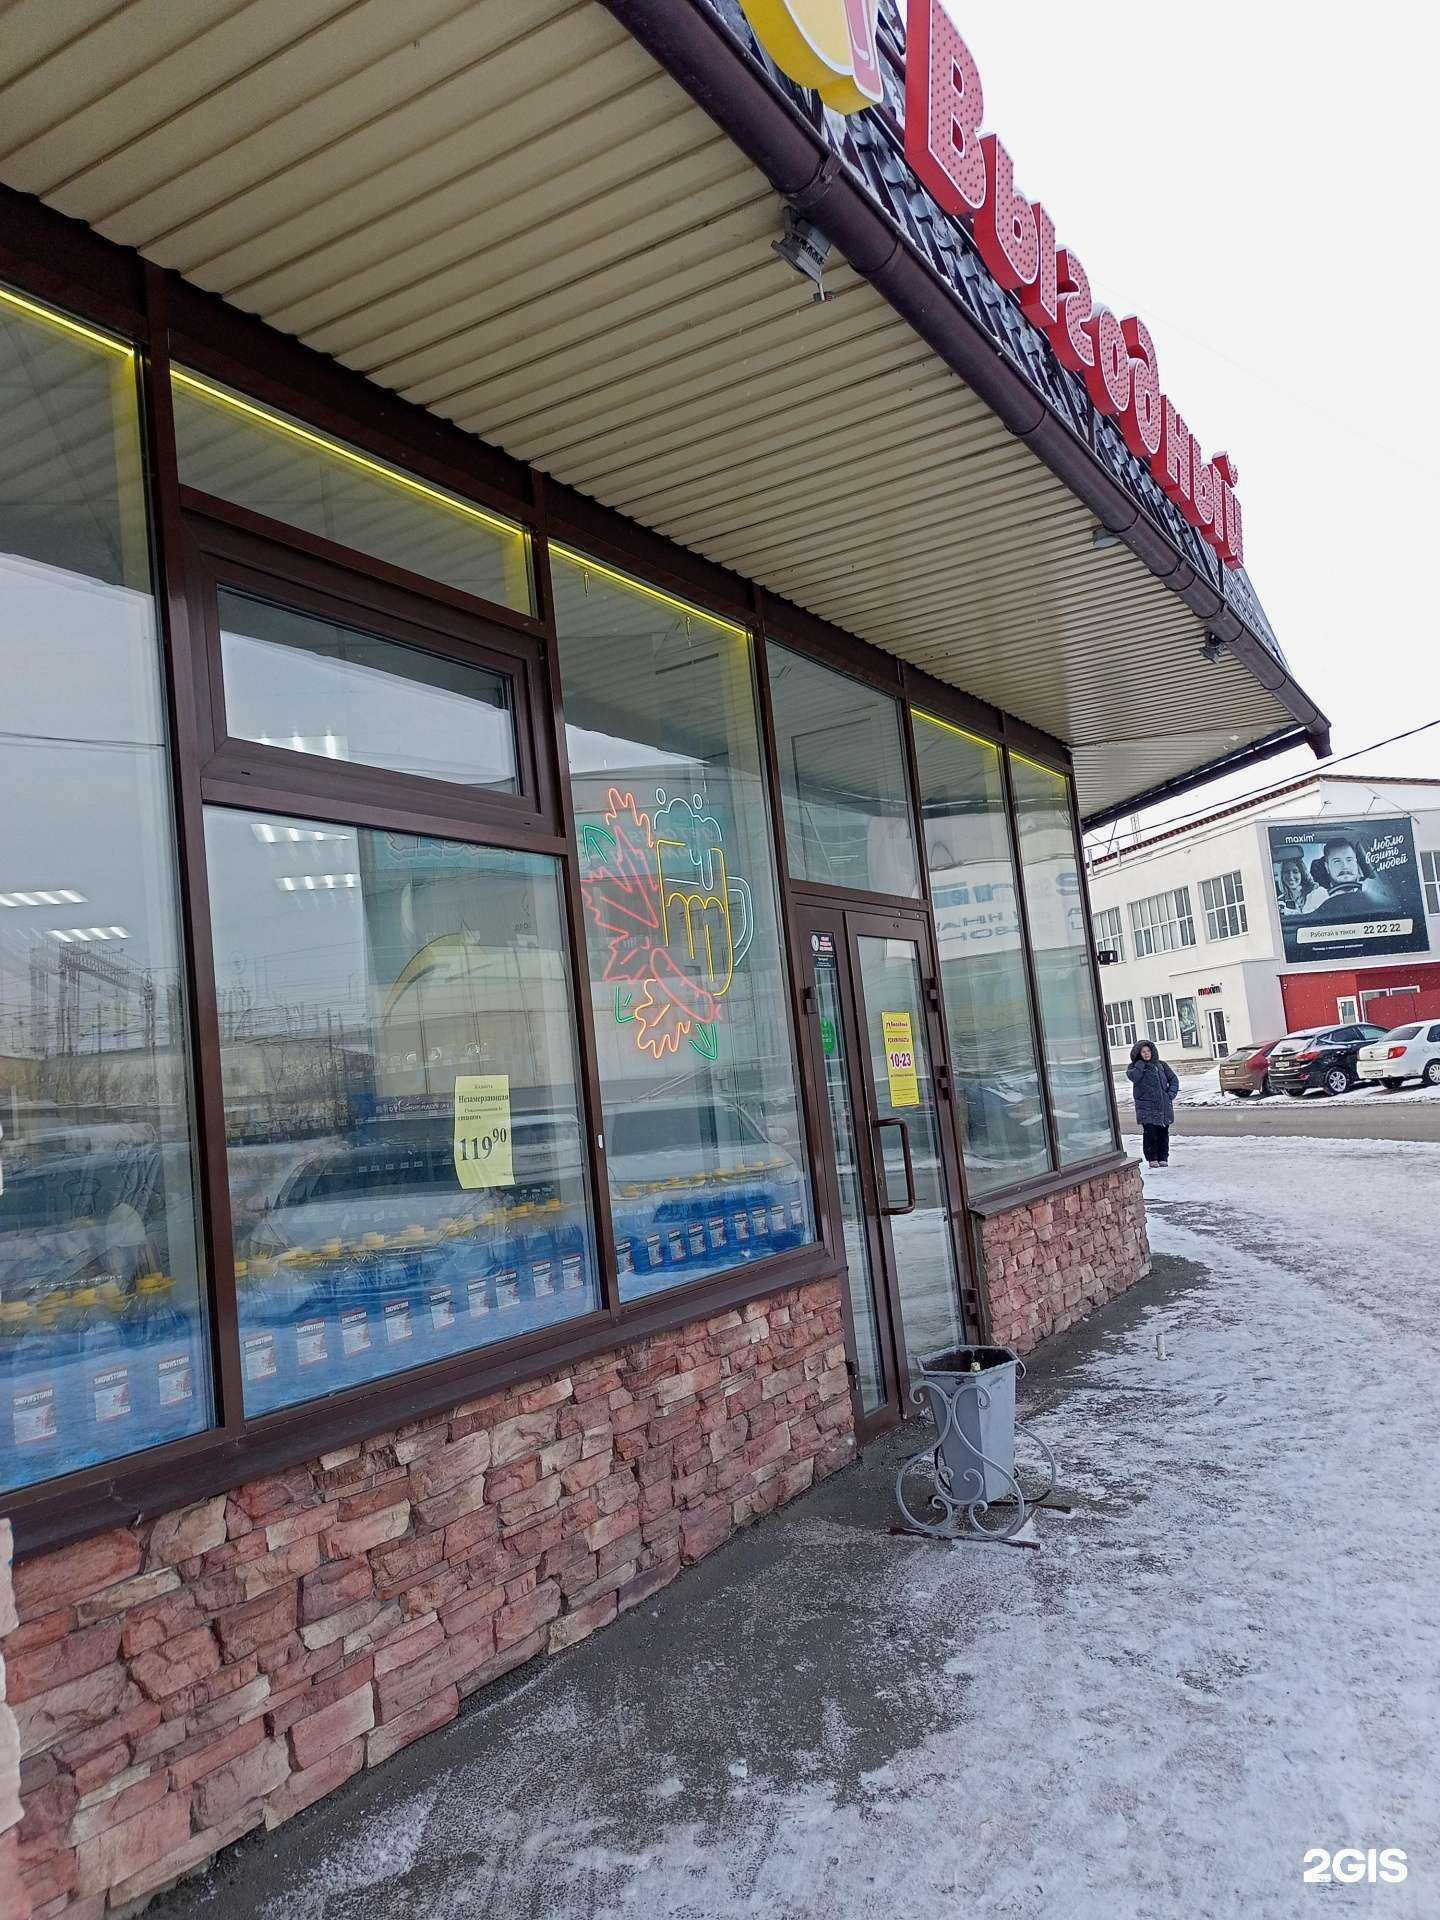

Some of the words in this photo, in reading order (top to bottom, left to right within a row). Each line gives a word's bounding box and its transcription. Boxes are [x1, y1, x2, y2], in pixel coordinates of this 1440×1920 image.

[905, 0, 1243, 568] Выгодный
[1285, 834, 1315, 844] maxim
[1370, 834, 1404, 852] Люблю
[1365, 847, 1399, 864] возить
[1377, 853, 1408, 872] людей
[1363, 925, 1375, 934] 22
[1376, 924, 1388, 933] 22
[1389, 923, 1401, 932] 22
[891, 1053, 912, 1068] 10-23
[460, 1136, 493, 1160] 119
